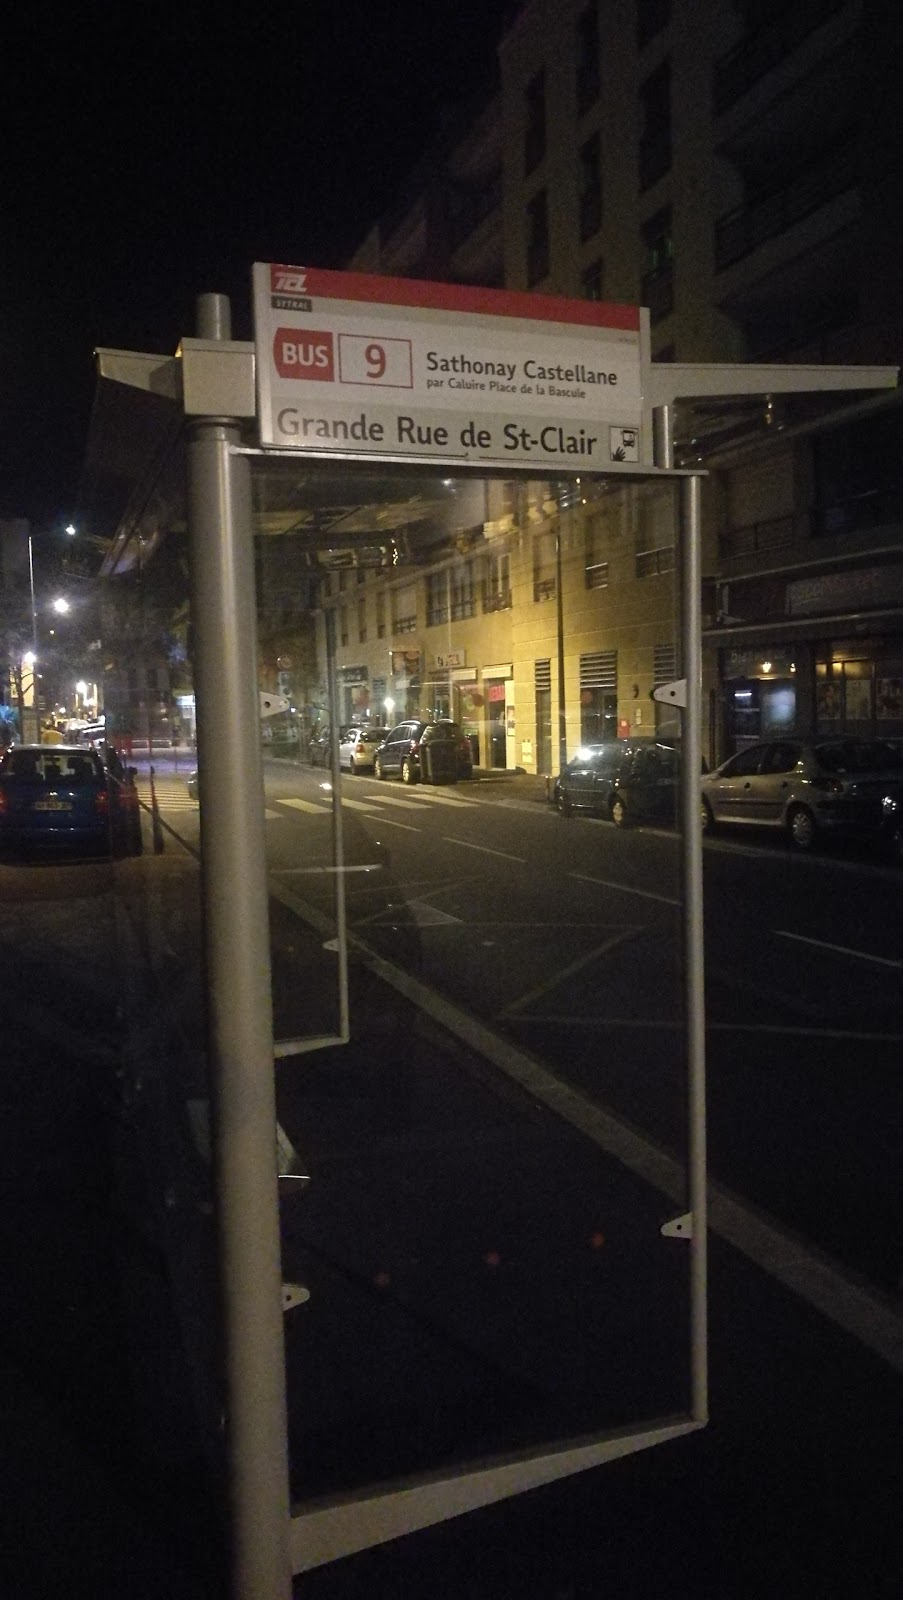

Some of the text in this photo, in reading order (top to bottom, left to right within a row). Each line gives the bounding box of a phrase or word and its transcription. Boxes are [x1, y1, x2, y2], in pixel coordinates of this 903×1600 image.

[282, 342, 329, 367] BUS
[364, 343, 387, 379] 9
[427, 352, 618, 386] Sathonay Castellane
[427, 378, 444, 390] par
[448, 377, 486, 391] Caluire
[489, 381, 517, 394] Place
[520, 383, 533, 395] de
[537, 384, 546, 396] la
[277, 408, 597, 455] Grande Rue de St-Clair
